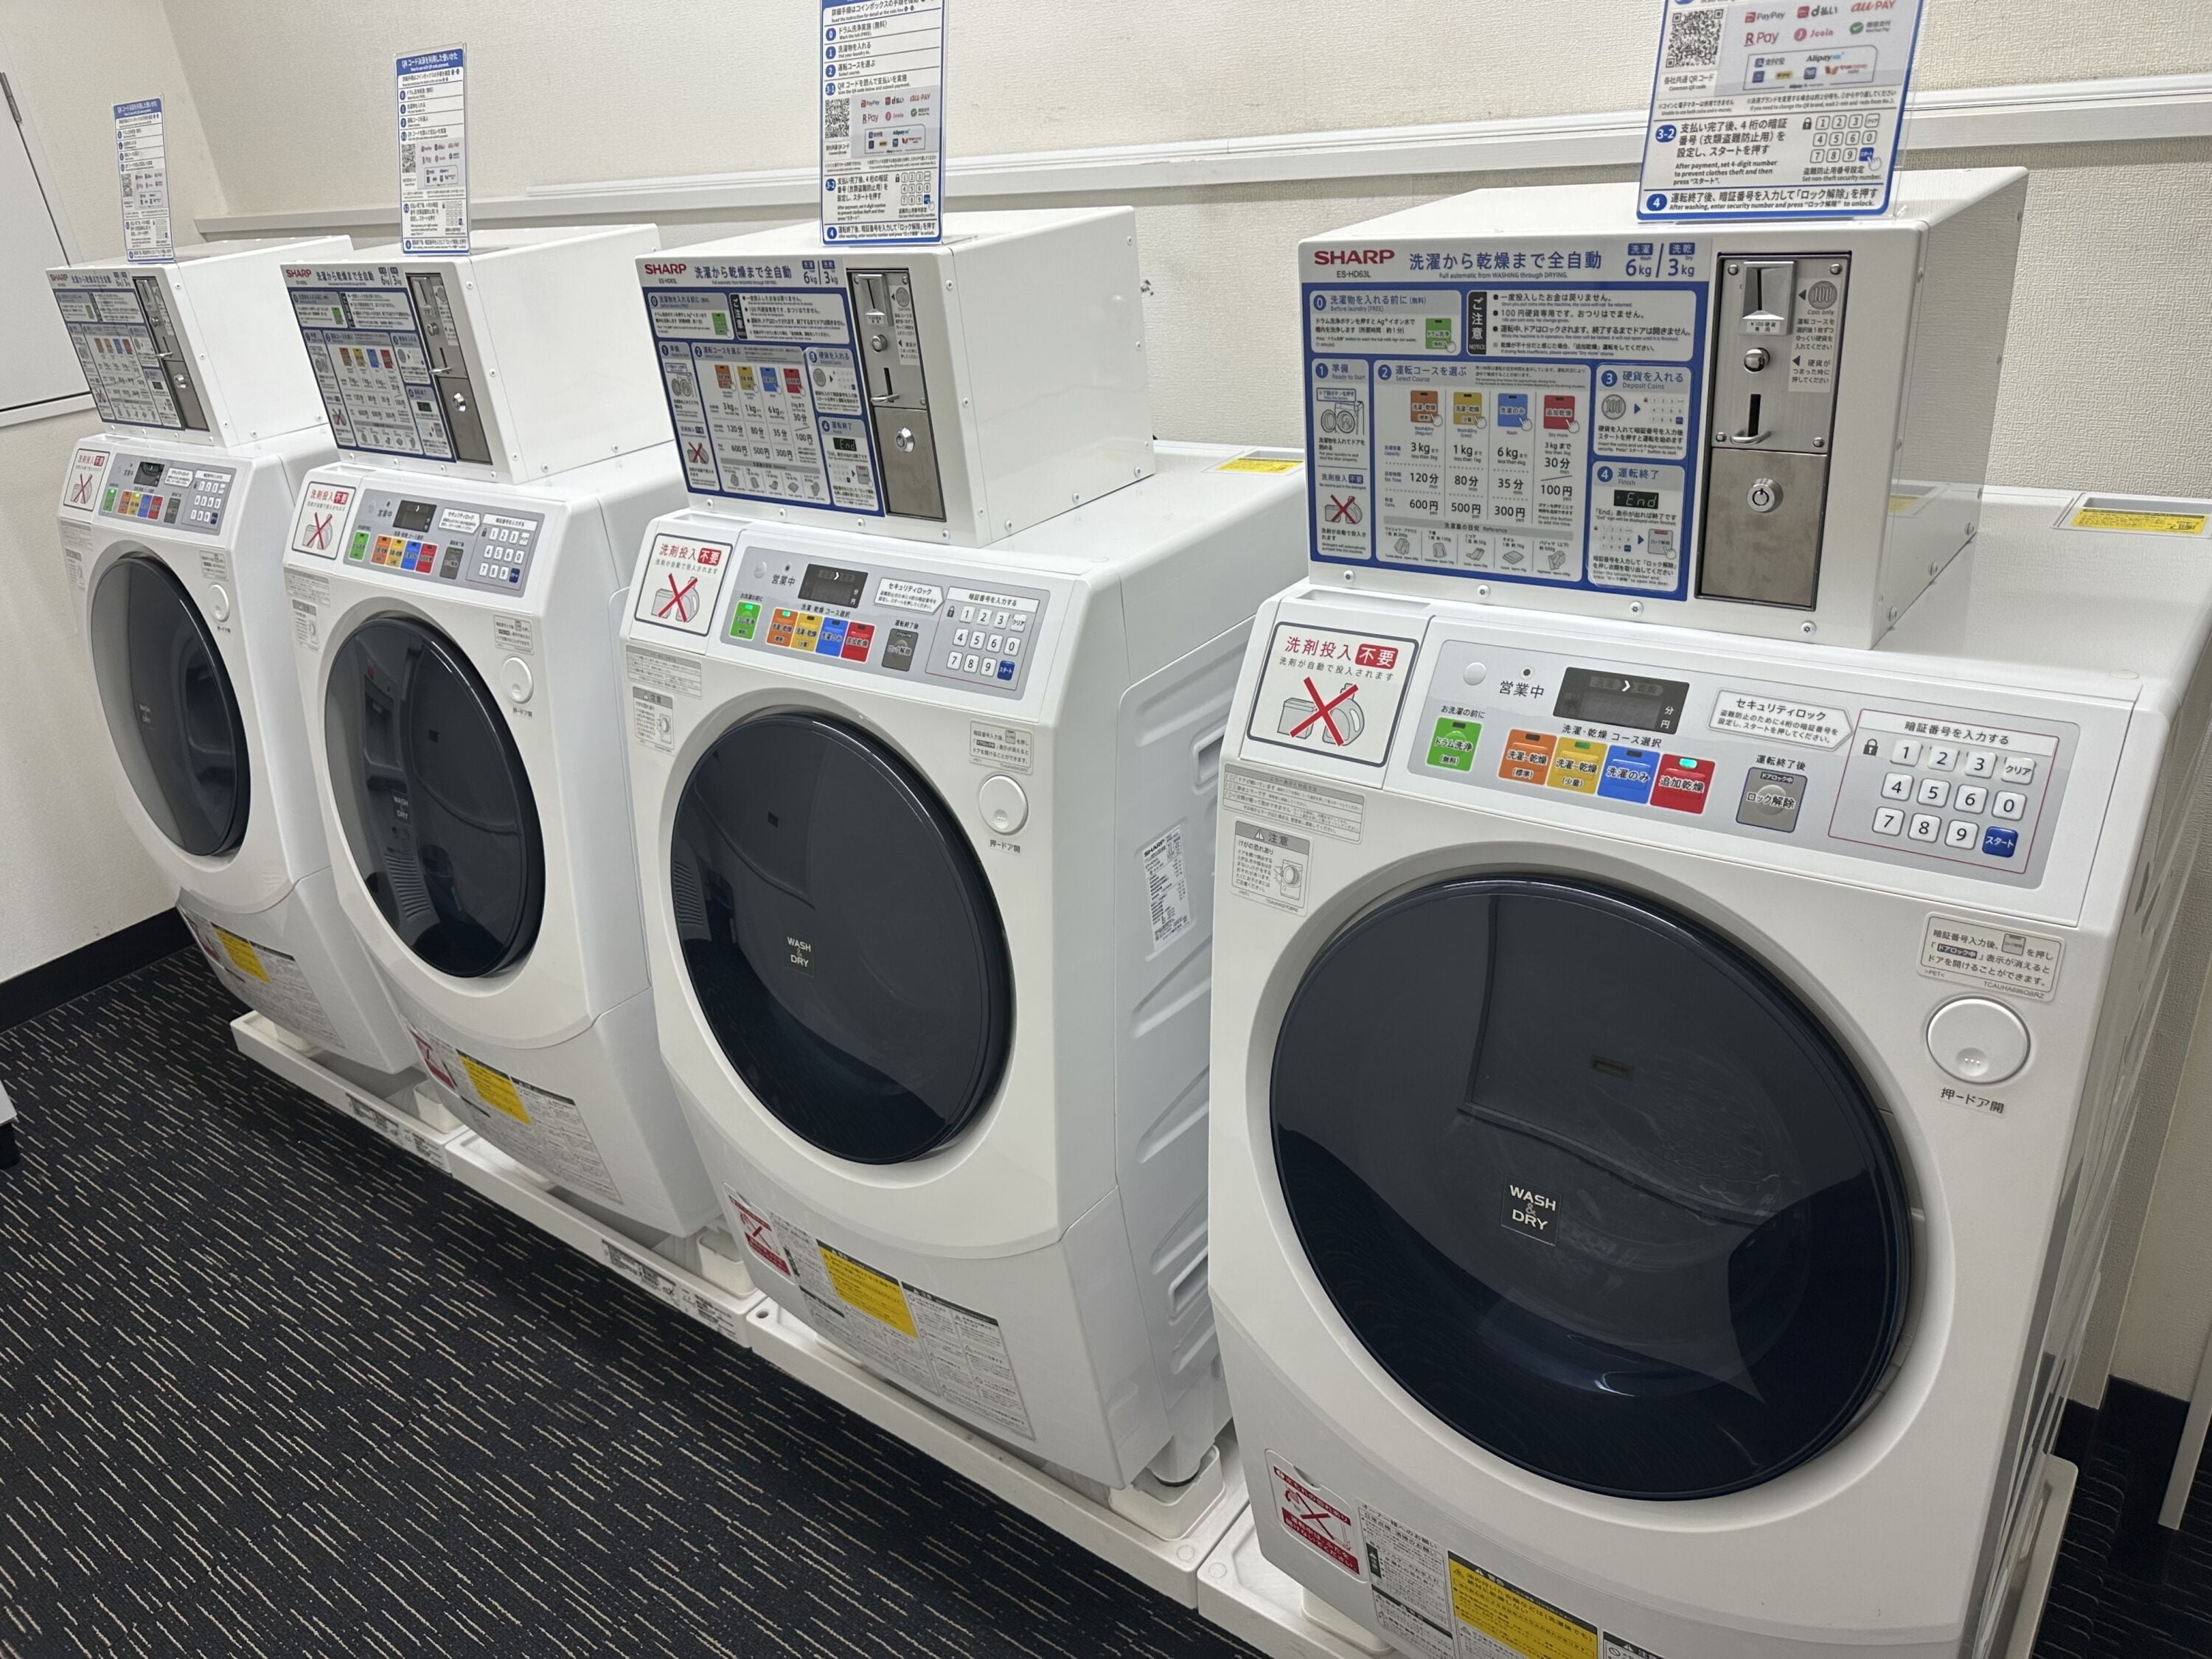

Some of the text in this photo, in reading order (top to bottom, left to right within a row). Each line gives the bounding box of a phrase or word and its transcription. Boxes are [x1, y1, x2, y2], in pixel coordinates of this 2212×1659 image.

[1875, 0, 1896, 10] PAY
[1757, 12, 1785, 20] PayPay
[1745, 32, 1778, 44] R Pay
[1657, 129, 1674, 139] 3-2
[1314, 249, 1395, 265] SHARP
[1409, 251, 1602, 270] 洗濯から乾燥まで全自動
[286, 269, 311, 278] SHARP
[644, 264, 686, 274] SHARP
[695, 265, 792, 279] 洗濯から乾燥まで全自動
[1330, 296, 1408, 305] 洗濯物を入れる前に
[1814, 286, 1833, 302] 100
[1332, 364, 1349, 373] 準備
[1396, 366, 1467, 376] 運転コースを選ぶ
[1622, 371, 1683, 382] 硬貨を入れる
[1410, 473, 1439, 484] 120分
[1618, 467, 1659, 479] 運転終了
[1455, 476, 1478, 487] 80分
[1498, 479, 1523, 490] 35分
[1541, 484, 1572, 496] 100円
[1409, 500, 1438, 511] 600円
[1626, 493, 1657, 507] End
[1451, 503, 1481, 514] 500円
[1495, 506, 1525, 518] 300円
[659, 543, 696, 560] 洗剤投入
[772, 574, 796, 587] 営業中
[965, 610, 1004, 625] 1 2 3
[958, 633, 1015, 650] 4 5 6 0
[1284, 636, 1396, 667] 洗剤投入 不要
[952, 656, 990, 671] 7 8 9
[1279, 656, 1394, 681] 洗剤が自動で投入されます
[1499, 680, 1545, 699] 営業中
[1441, 705, 1486, 718] お洗濯の前に
[1664, 706, 1674, 714] 分
[1736, 698, 1826, 720] セキュリティロック
[1660, 720, 1670, 728] 円
[1905, 721, 2008, 744] 暗証番号を入力する
[1435, 737, 1472, 751] ドラム洗浄
[1612, 732, 1662, 748] コース選択
[1756, 754, 1806, 771] 運転終了後
[1903, 746, 1984, 771] 1 2 3
[1607, 768, 1649, 782] 洗濯のみ
[2006, 765, 2031, 775] クリア
[1660, 777, 1704, 791] 追加乾燥
[1747, 793, 1795, 808] ロック解除
[1891, 781, 2014, 812] 4 5 6 0
[1884, 815, 1967, 841] 7 8 9
[1268, 832, 1289, 846] 注意
[1985, 835, 2014, 847] スタート
[1144, 838, 1165, 857] SHARP
[787, 936, 811, 952] WASH
[790, 954, 808, 967] DRY
[1510, 1185, 1556, 1211] WASH
[1526, 1203, 1536, 1217] &
[1512, 1209, 1548, 1230] DRY
